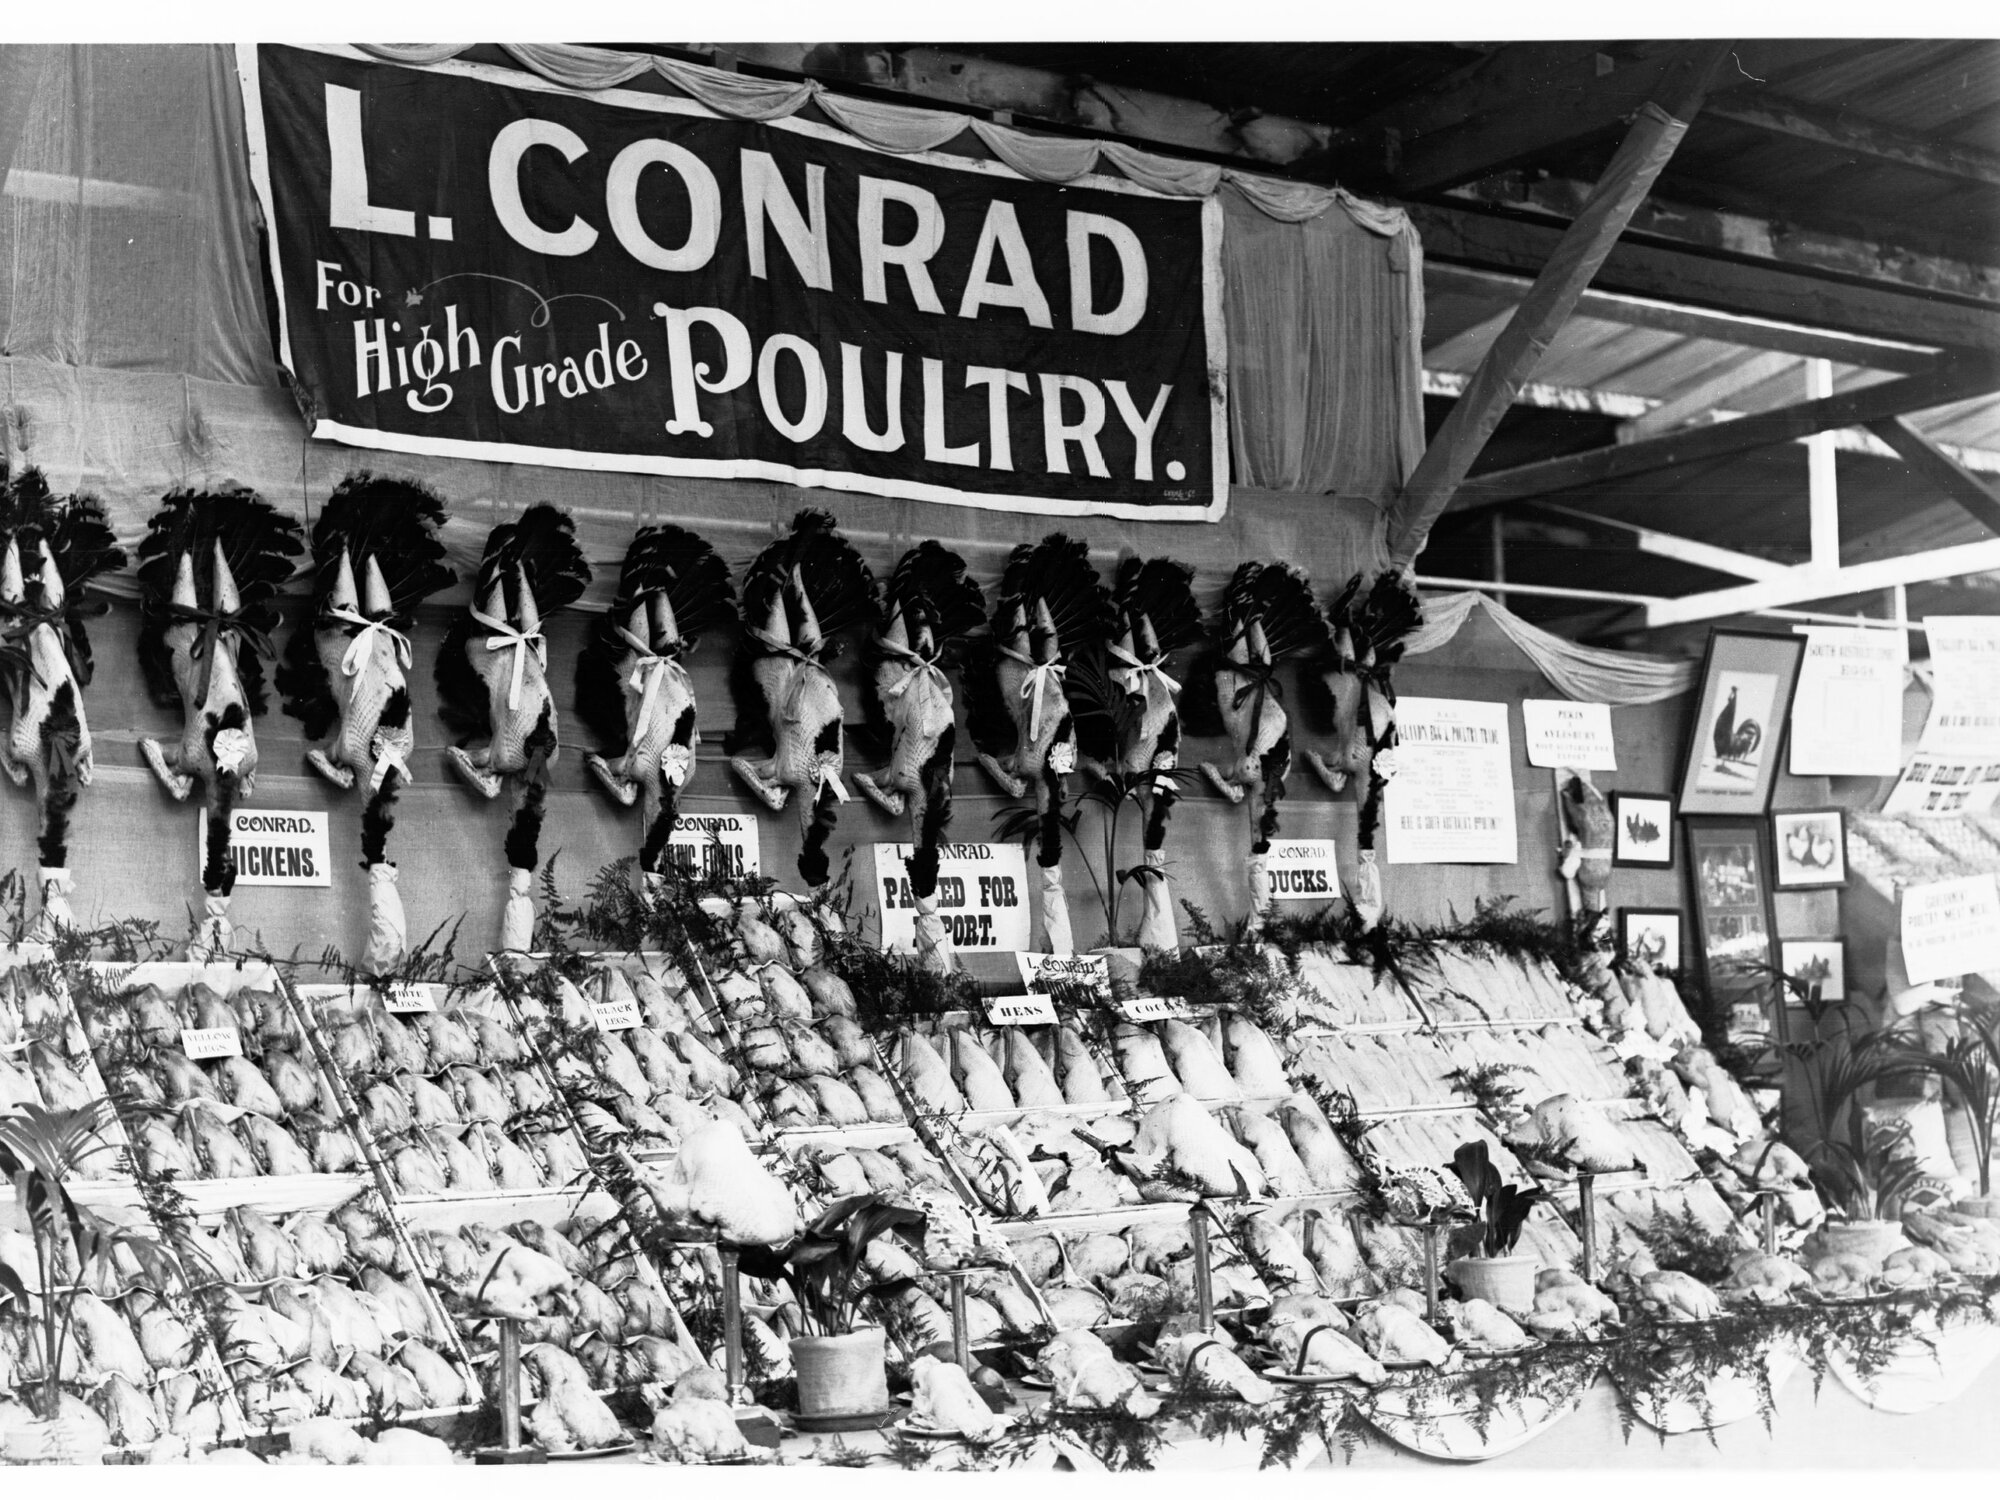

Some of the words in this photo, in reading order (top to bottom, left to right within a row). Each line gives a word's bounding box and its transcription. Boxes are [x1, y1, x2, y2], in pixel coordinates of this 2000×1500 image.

[324, 82, 454, 241] L.
[488, 117, 1149, 337] CONRAD
[315, 259, 382, 311] For
[354, 304, 481, 414] High
[490, 321, 649, 414] Grade
[653, 302, 1187, 482] POULTRY.
[236, 815, 315, 833] CONRAD.
[228, 845, 320, 877] HICKENS.
[936, 844, 994, 860] ONRAD.
[883, 876, 966, 909] PAED
[978, 876, 1019, 908] FOR
[1267, 869, 1333, 894] DUCKS.
[913, 914, 997, 948] PORT.
[596, 1003, 632, 1015] BLACK
[1000, 1006, 1044, 1018] HENS
[1135, 1001, 1184, 1014] COCKS
[187, 1032, 232, 1042] YELLOW
